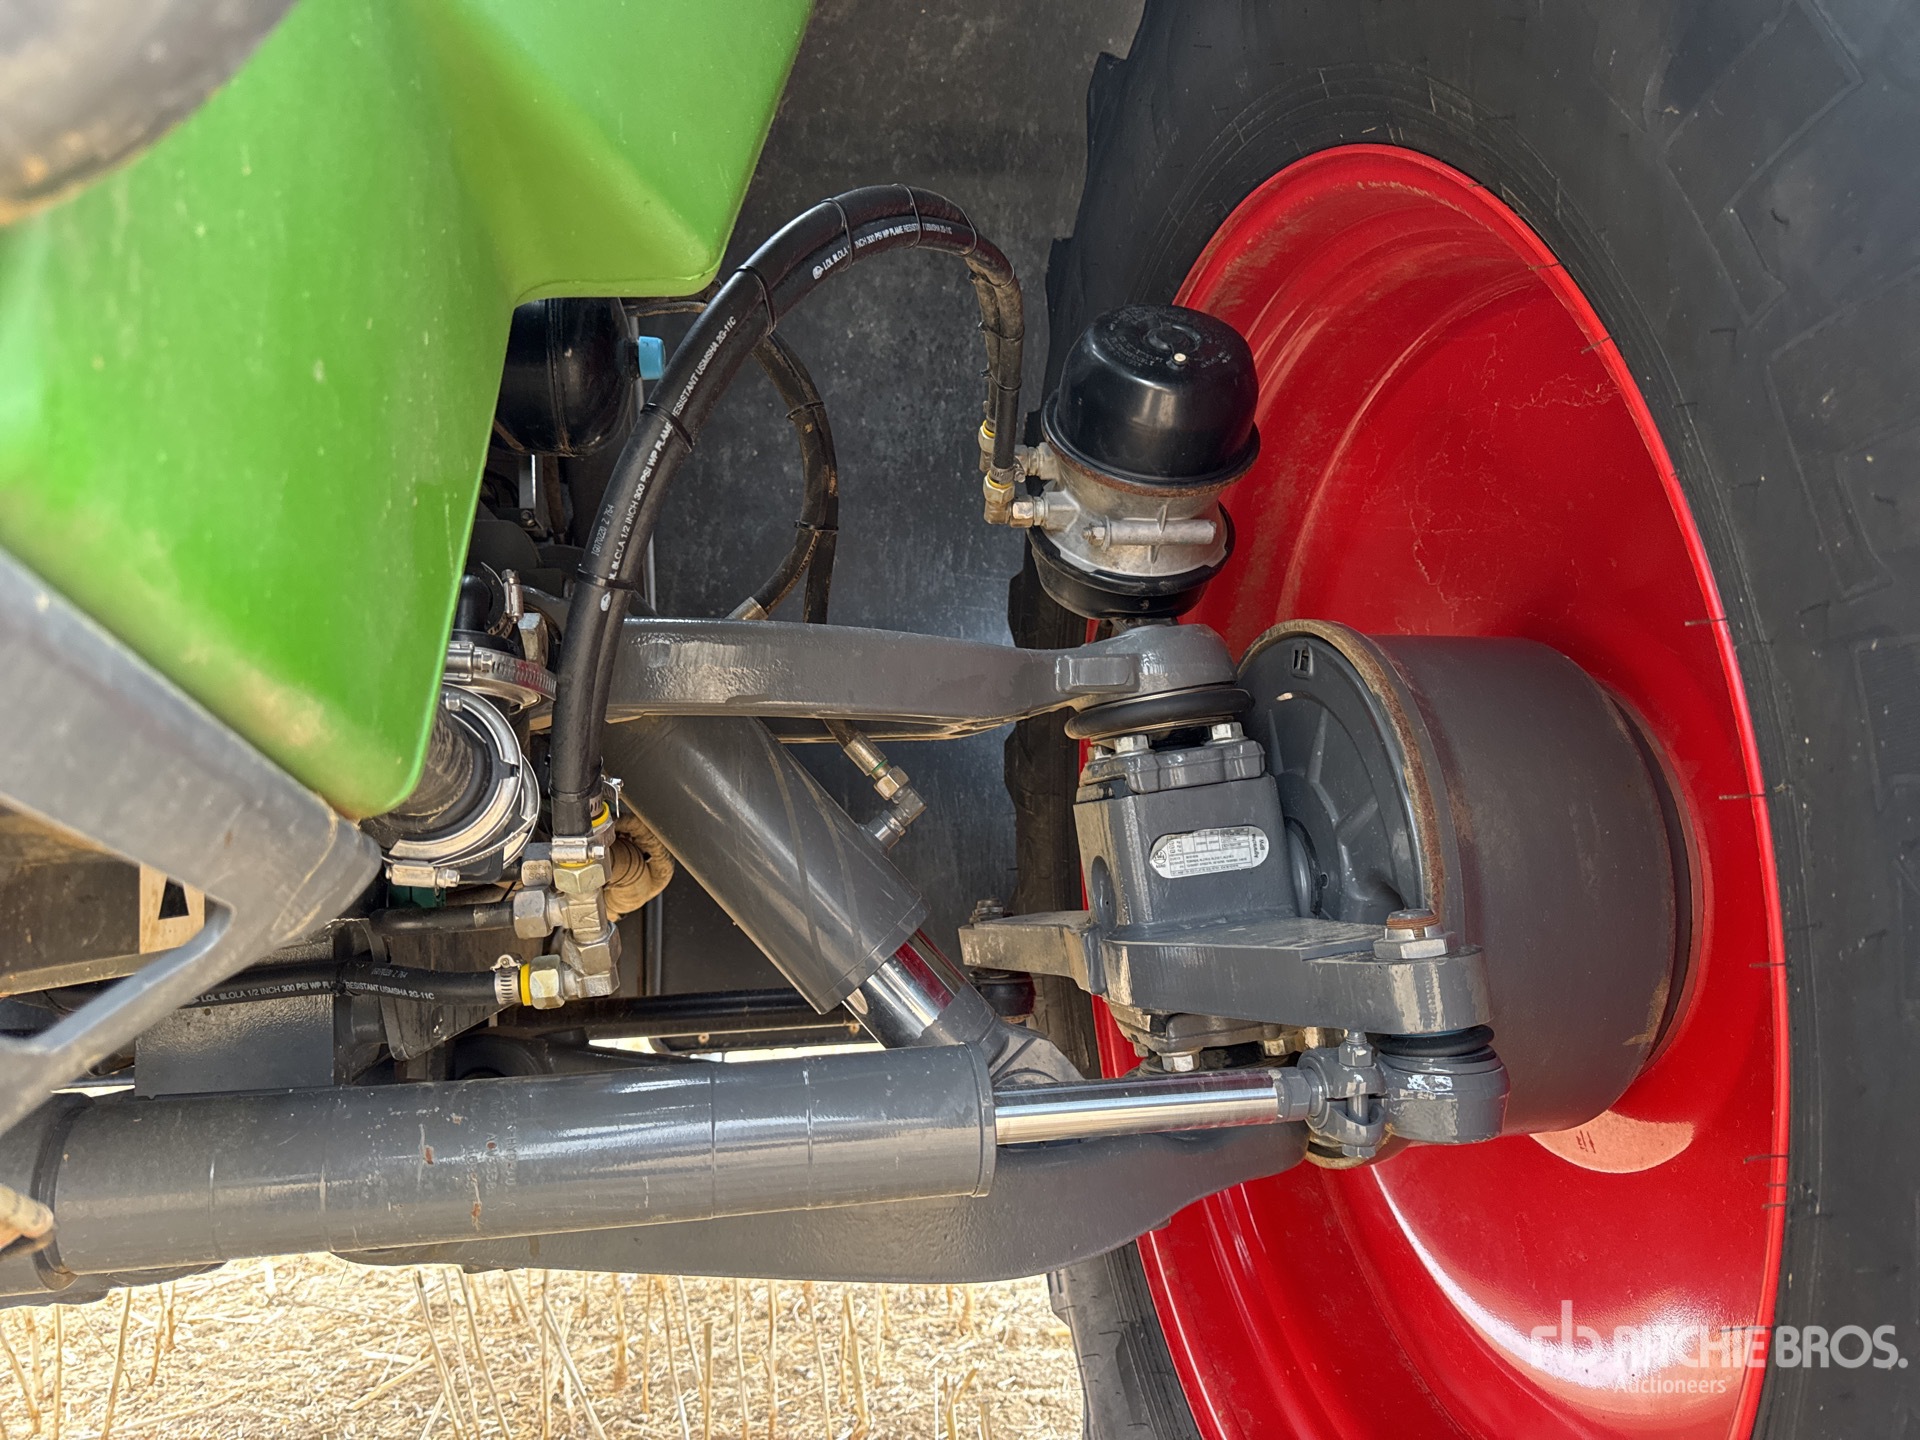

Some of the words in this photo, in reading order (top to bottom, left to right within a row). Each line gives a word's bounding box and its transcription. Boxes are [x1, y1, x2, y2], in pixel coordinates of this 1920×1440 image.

[715, 316, 737, 345] 2G-11C
[695, 341, 719, 375] USMSHA
[647, 451, 658, 469] WP
[640, 467, 652, 482] PSI
[634, 483, 645, 501] 300
[625, 500, 639, 525] INCH
[621, 525, 631, 538] 1/2
[247, 988, 259, 997] 1/2
[260, 985, 281, 995] INCH
[281, 983, 295, 993] 300
[296, 981, 309, 991] PSI
[309, 980, 322, 990] WP
